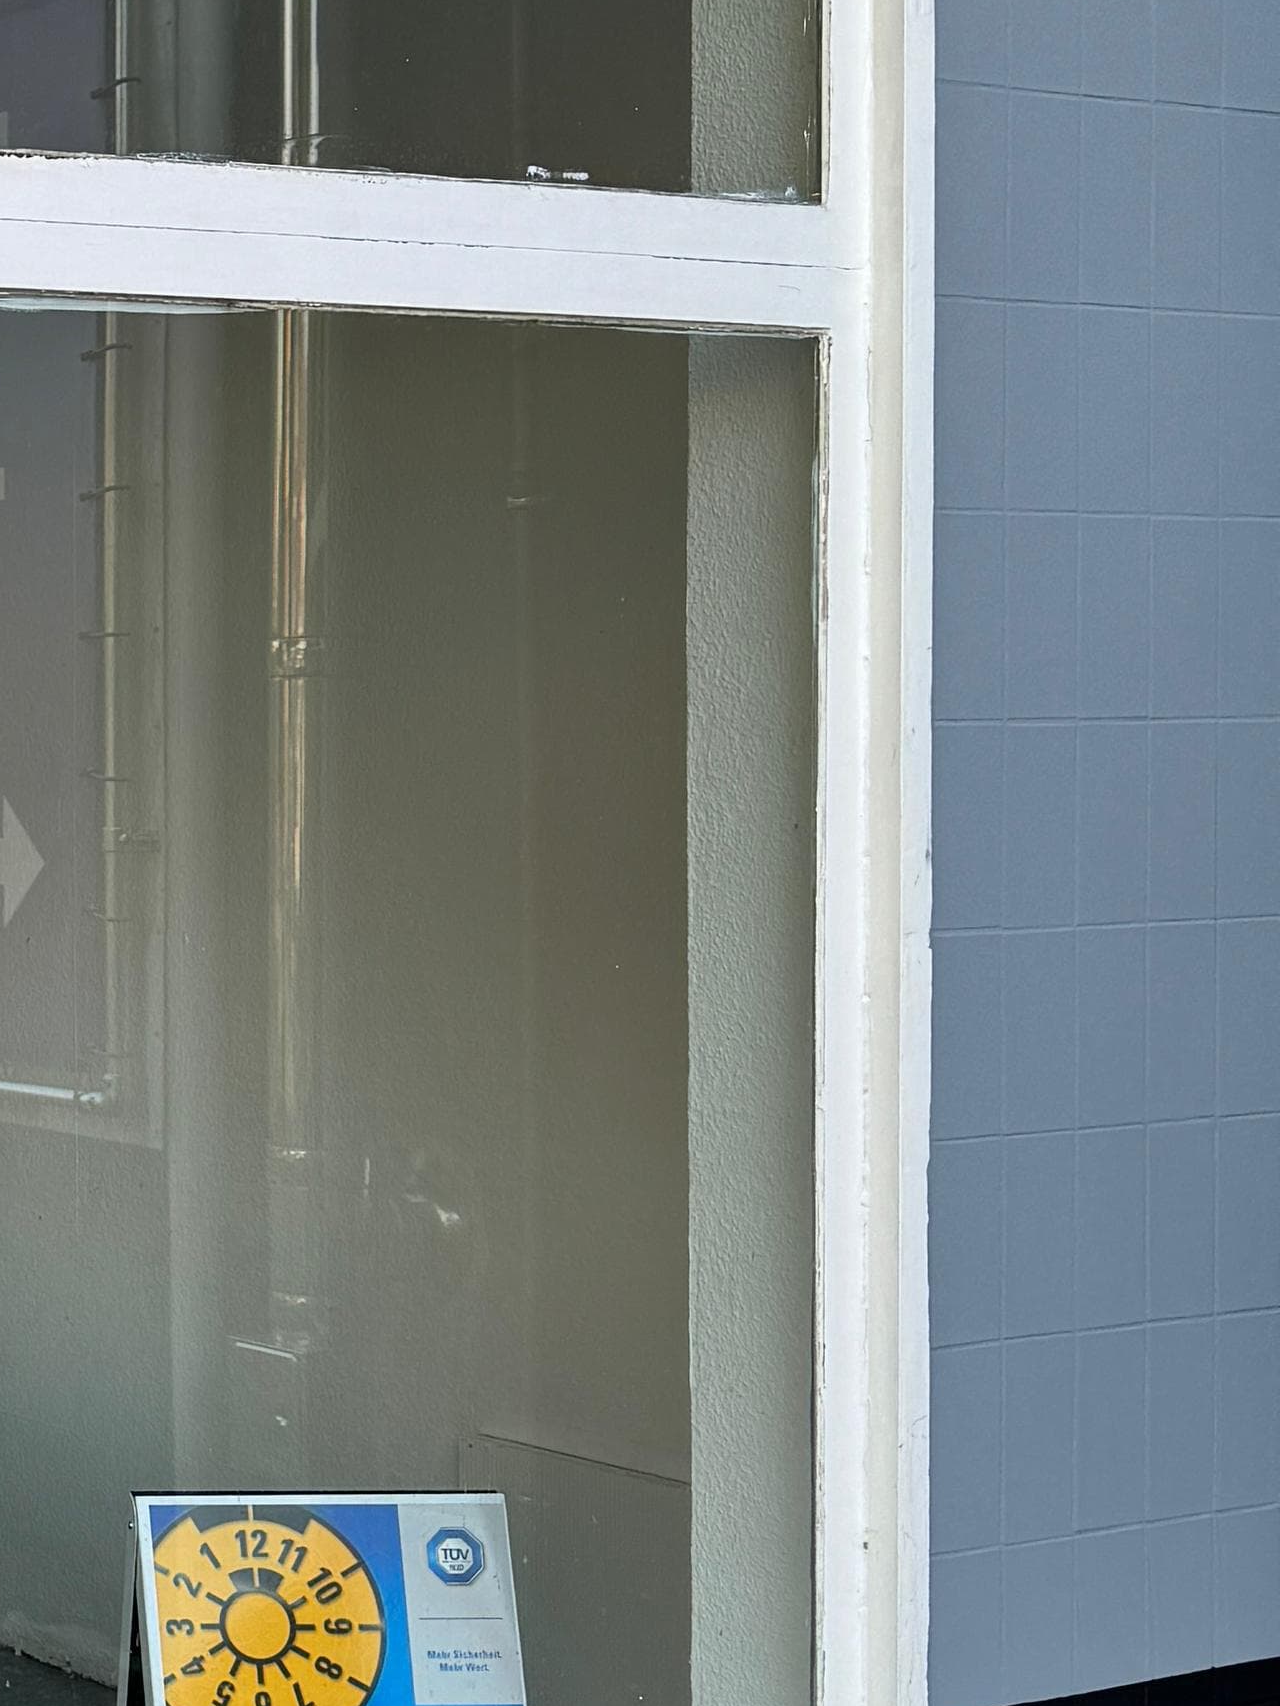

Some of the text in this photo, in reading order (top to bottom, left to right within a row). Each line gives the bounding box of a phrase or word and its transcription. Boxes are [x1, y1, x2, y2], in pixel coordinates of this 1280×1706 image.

[199, 1542, 221, 1569] 1
[234, 1529, 269, 1558] 12
[277, 1538, 308, 1573] 11
[172, 1572, 202, 1598] 2
[307, 1566, 343, 1605] 10
[165, 1618, 195, 1636] 3
[324, 1618, 353, 1635] 9
[180, 1655, 205, 1676] 4
[314, 1656, 343, 1680] 8
